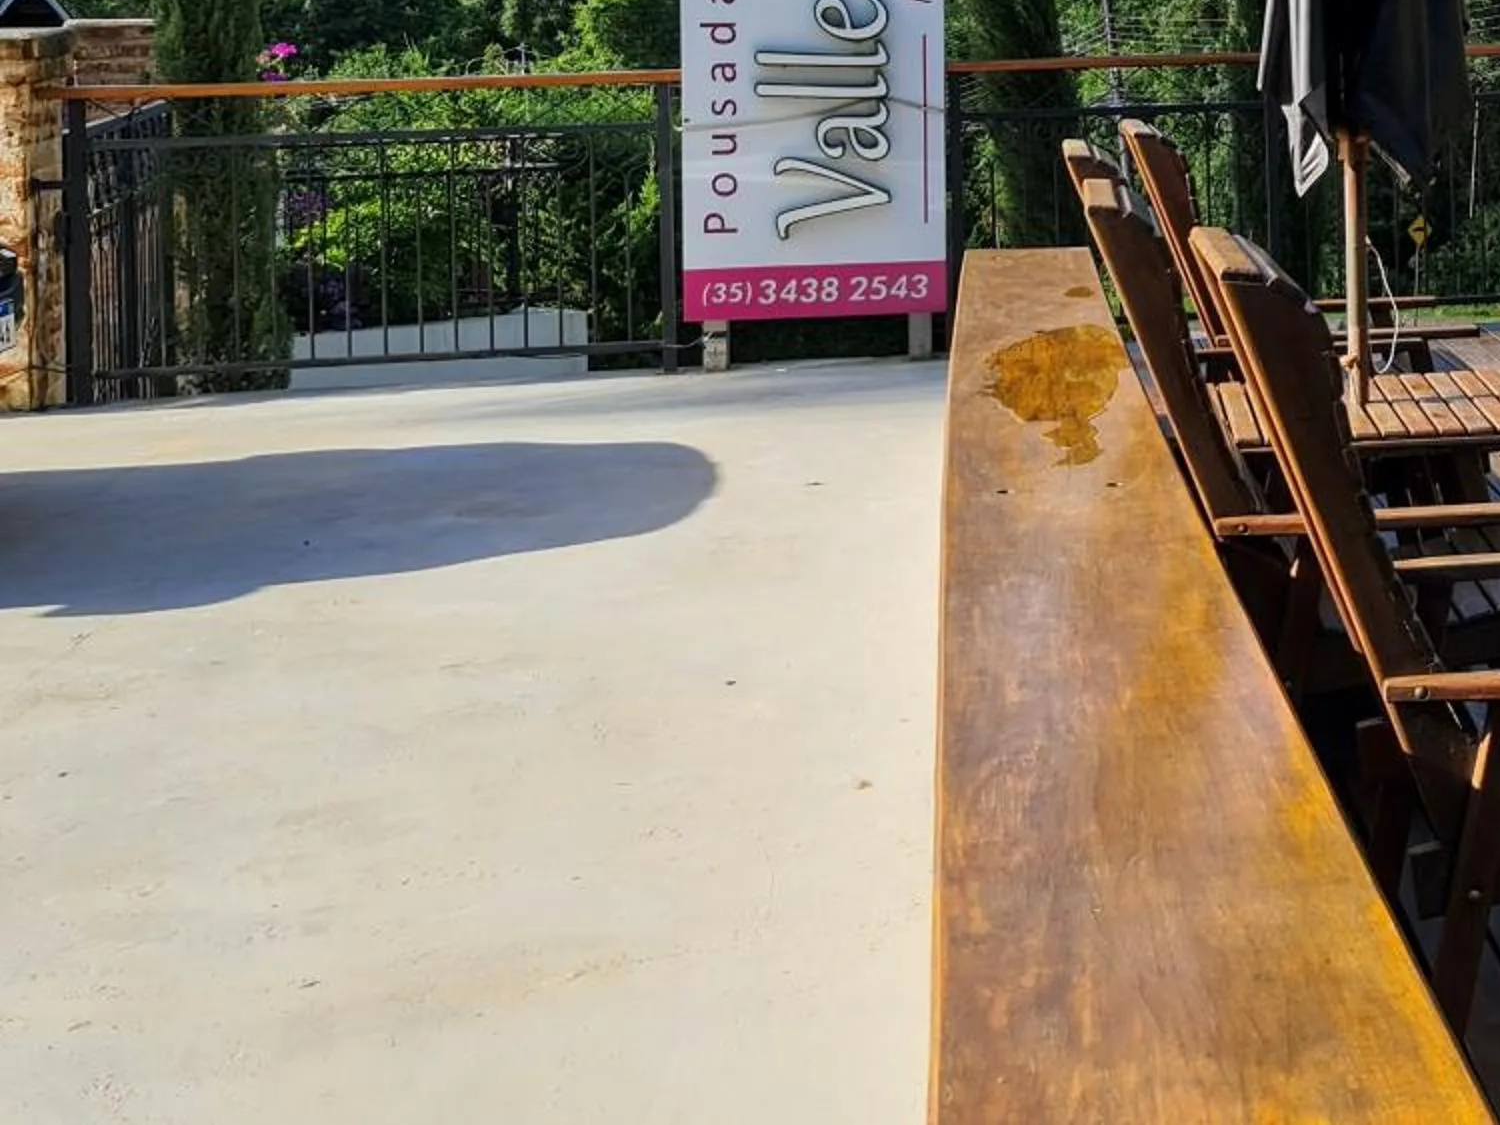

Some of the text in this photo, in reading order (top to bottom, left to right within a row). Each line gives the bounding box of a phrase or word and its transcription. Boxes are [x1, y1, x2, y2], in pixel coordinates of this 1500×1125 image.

[702, 273, 930, 307] (35) 3438 2543
